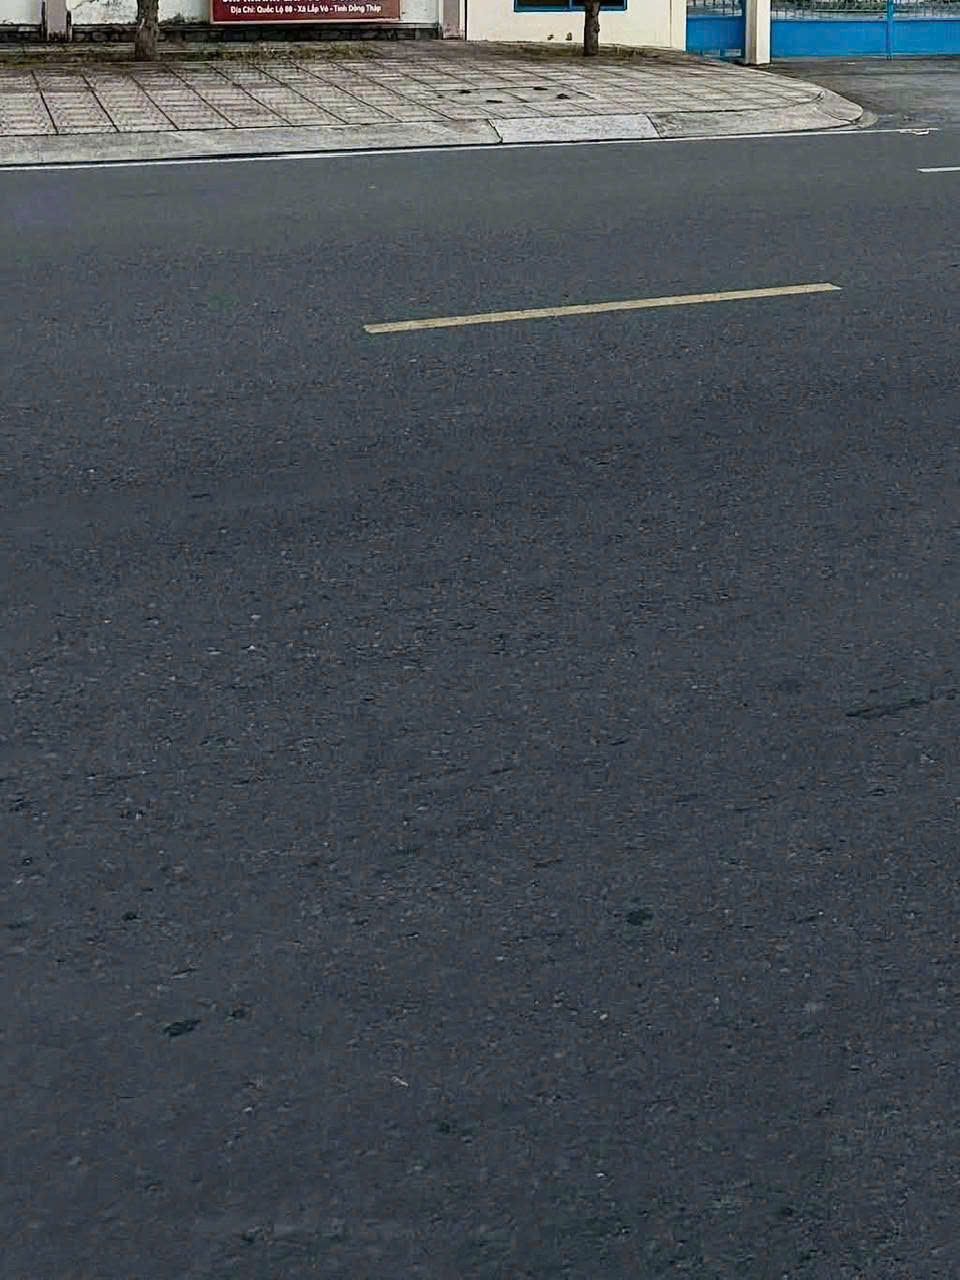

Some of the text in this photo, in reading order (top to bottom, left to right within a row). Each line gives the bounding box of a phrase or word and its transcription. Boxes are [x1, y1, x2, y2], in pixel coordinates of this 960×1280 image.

[230, 5, 241, 15] Địa
[257, 4, 274, 14] Quốc
[275, 5, 283, 15] Lộ
[297, 4, 306, 13] Xã
[307, 3, 319, 13] Lấp
[348, 3, 365, 13] Đồng
[366, 3, 381, 13] Tháp
